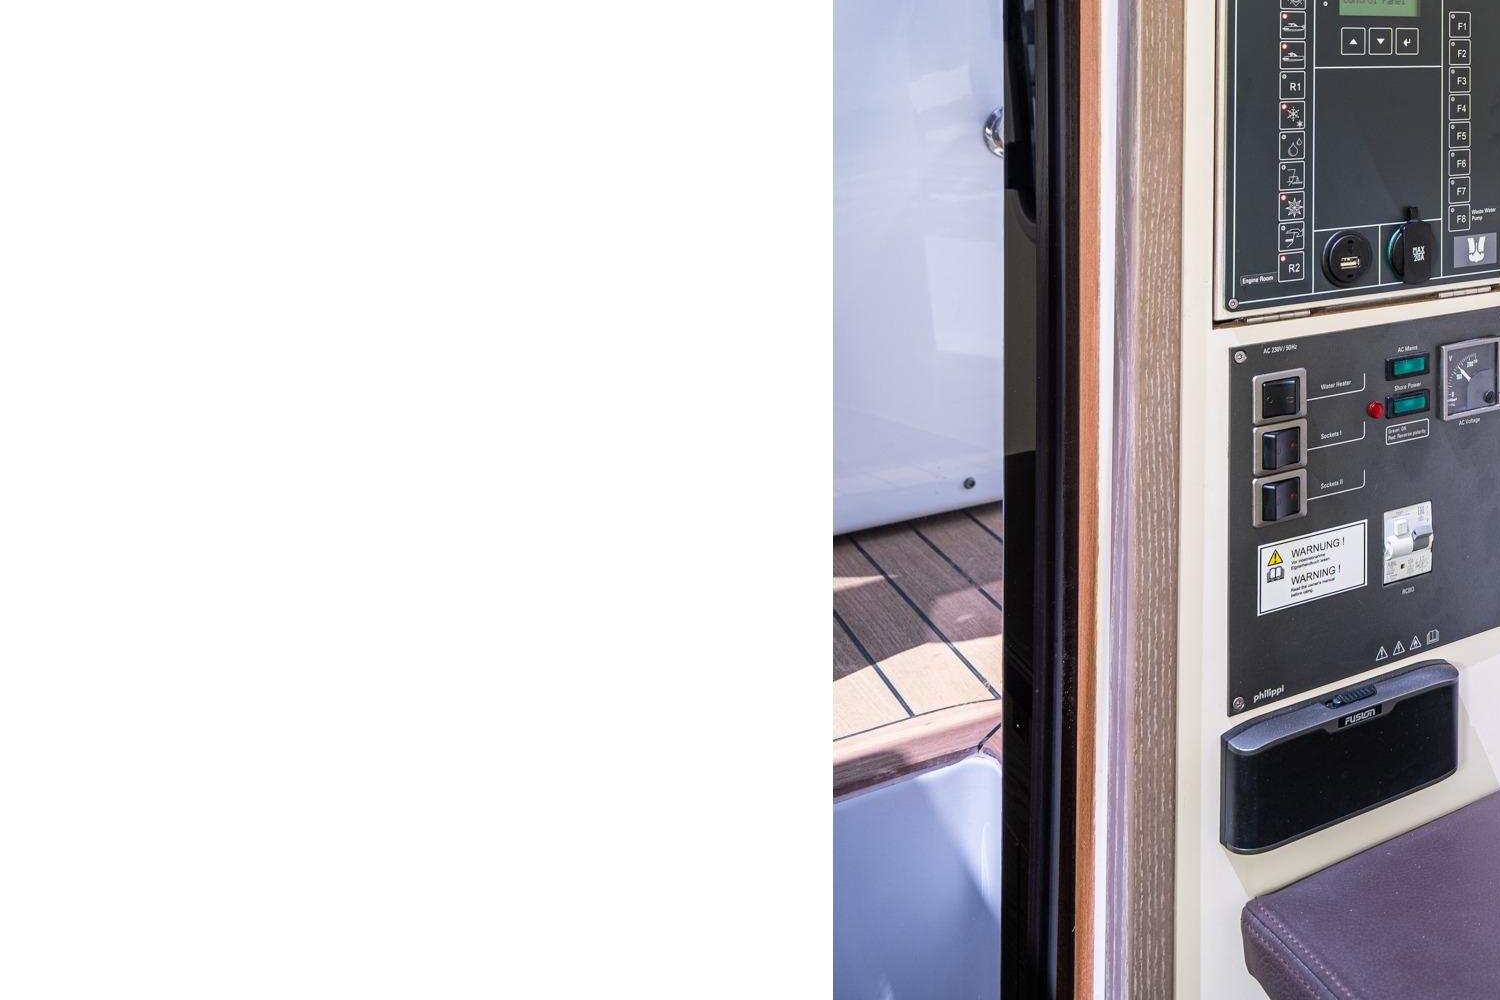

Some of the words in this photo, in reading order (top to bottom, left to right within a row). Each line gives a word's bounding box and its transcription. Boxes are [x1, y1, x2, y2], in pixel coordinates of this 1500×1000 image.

[1458, 22, 1467, 31] F1
[1457, 50, 1467, 58] F2
[1457, 77, 1467, 85] F3
[1290, 82, 1301, 91] R1
[1457, 105, 1467, 113] F4
[1457, 132, 1467, 140] F5
[1457, 160, 1467, 168] F6
[1457, 187, 1467, 196] F7
[1457, 215, 1467, 224] F8
[1288, 264, 1300, 273] R2
[1242, 276, 1259, 285] Engine
[1259, 274, 1274, 282] Room
[1336, 380, 1351, 388] Heater
[1291, 538, 1340, 558] WARNUNG
[1291, 566, 1336, 585] WARNING
[1253, 684, 1284, 704] philippi
